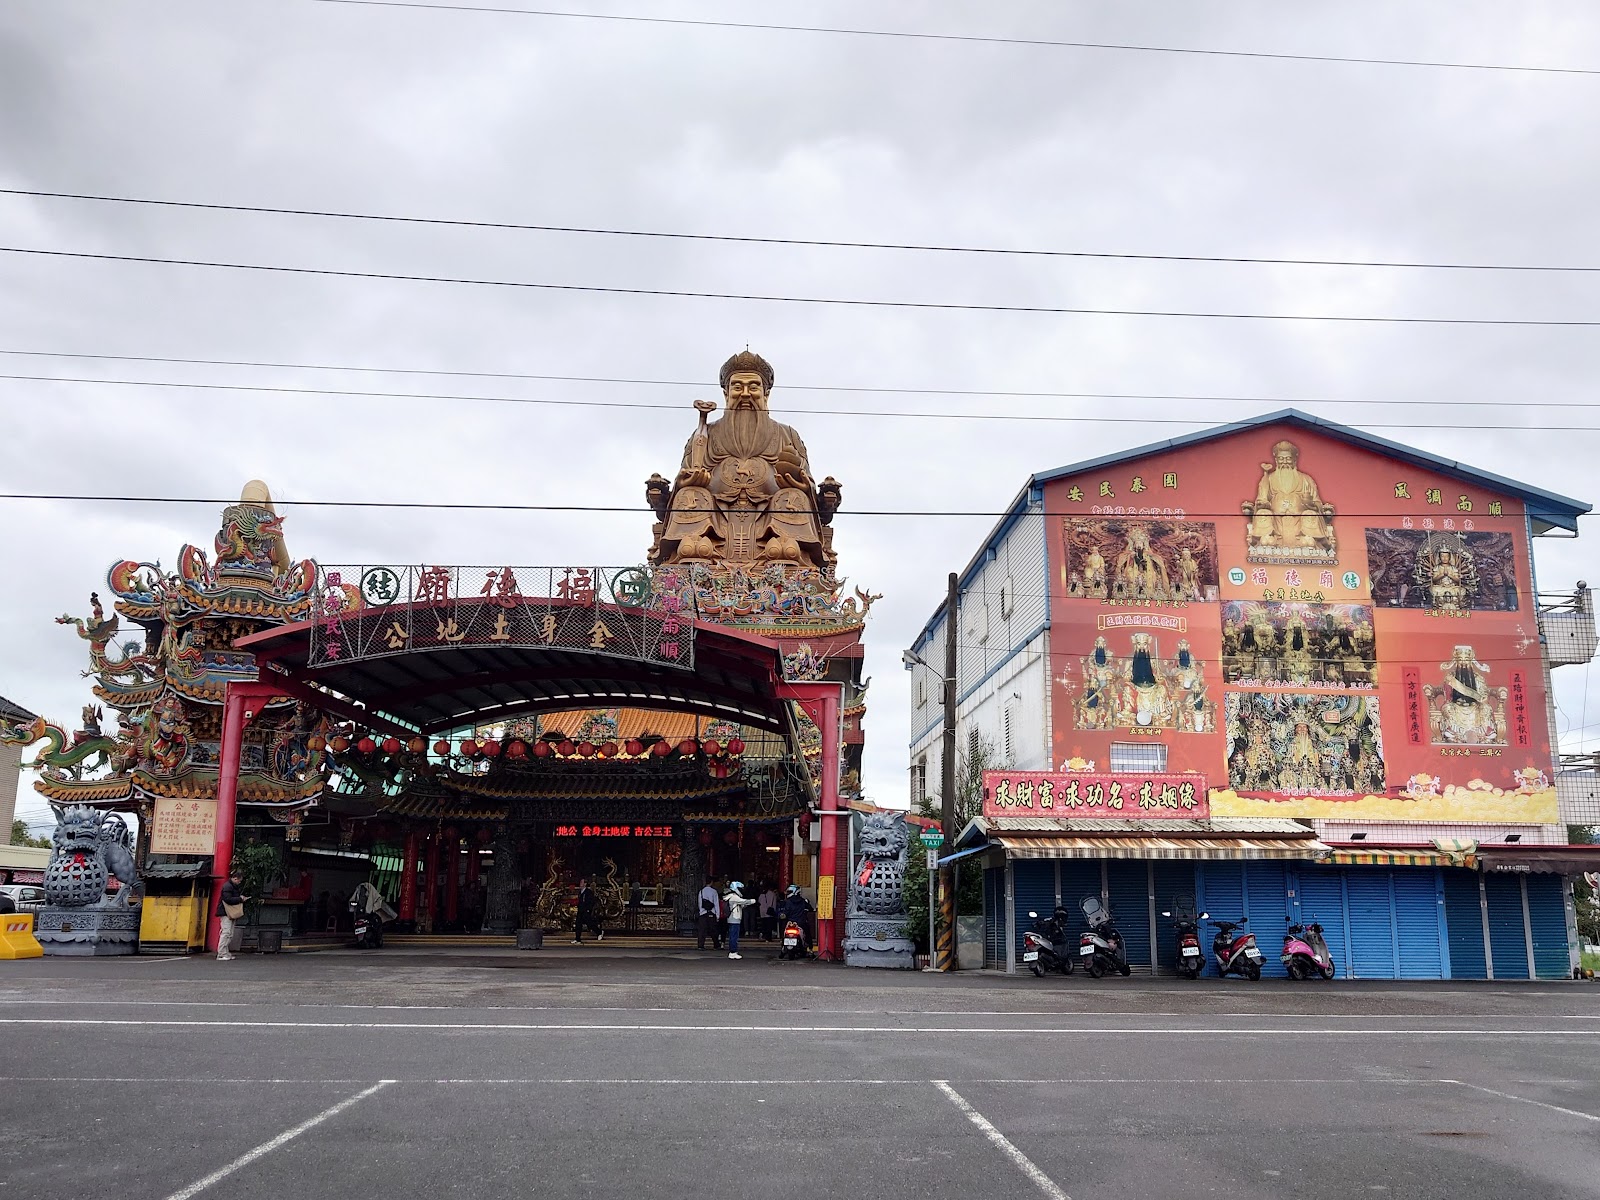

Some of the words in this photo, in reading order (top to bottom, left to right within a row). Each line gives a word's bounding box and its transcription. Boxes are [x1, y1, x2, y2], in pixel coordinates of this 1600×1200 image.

[1394, 482, 1503, 518] 風調雨順
[1263, 588, 1325, 603] 金身土地公
[325, 571, 341, 659] 國泰民安
[660, 571, 681, 659] 風調雨順
[383, 613, 615, 649] 金身土地公
[1129, 727, 1162, 736] 五路財神
[175, 802, 200, 811] 公告
[634, 827, 673, 837] 古公三王
